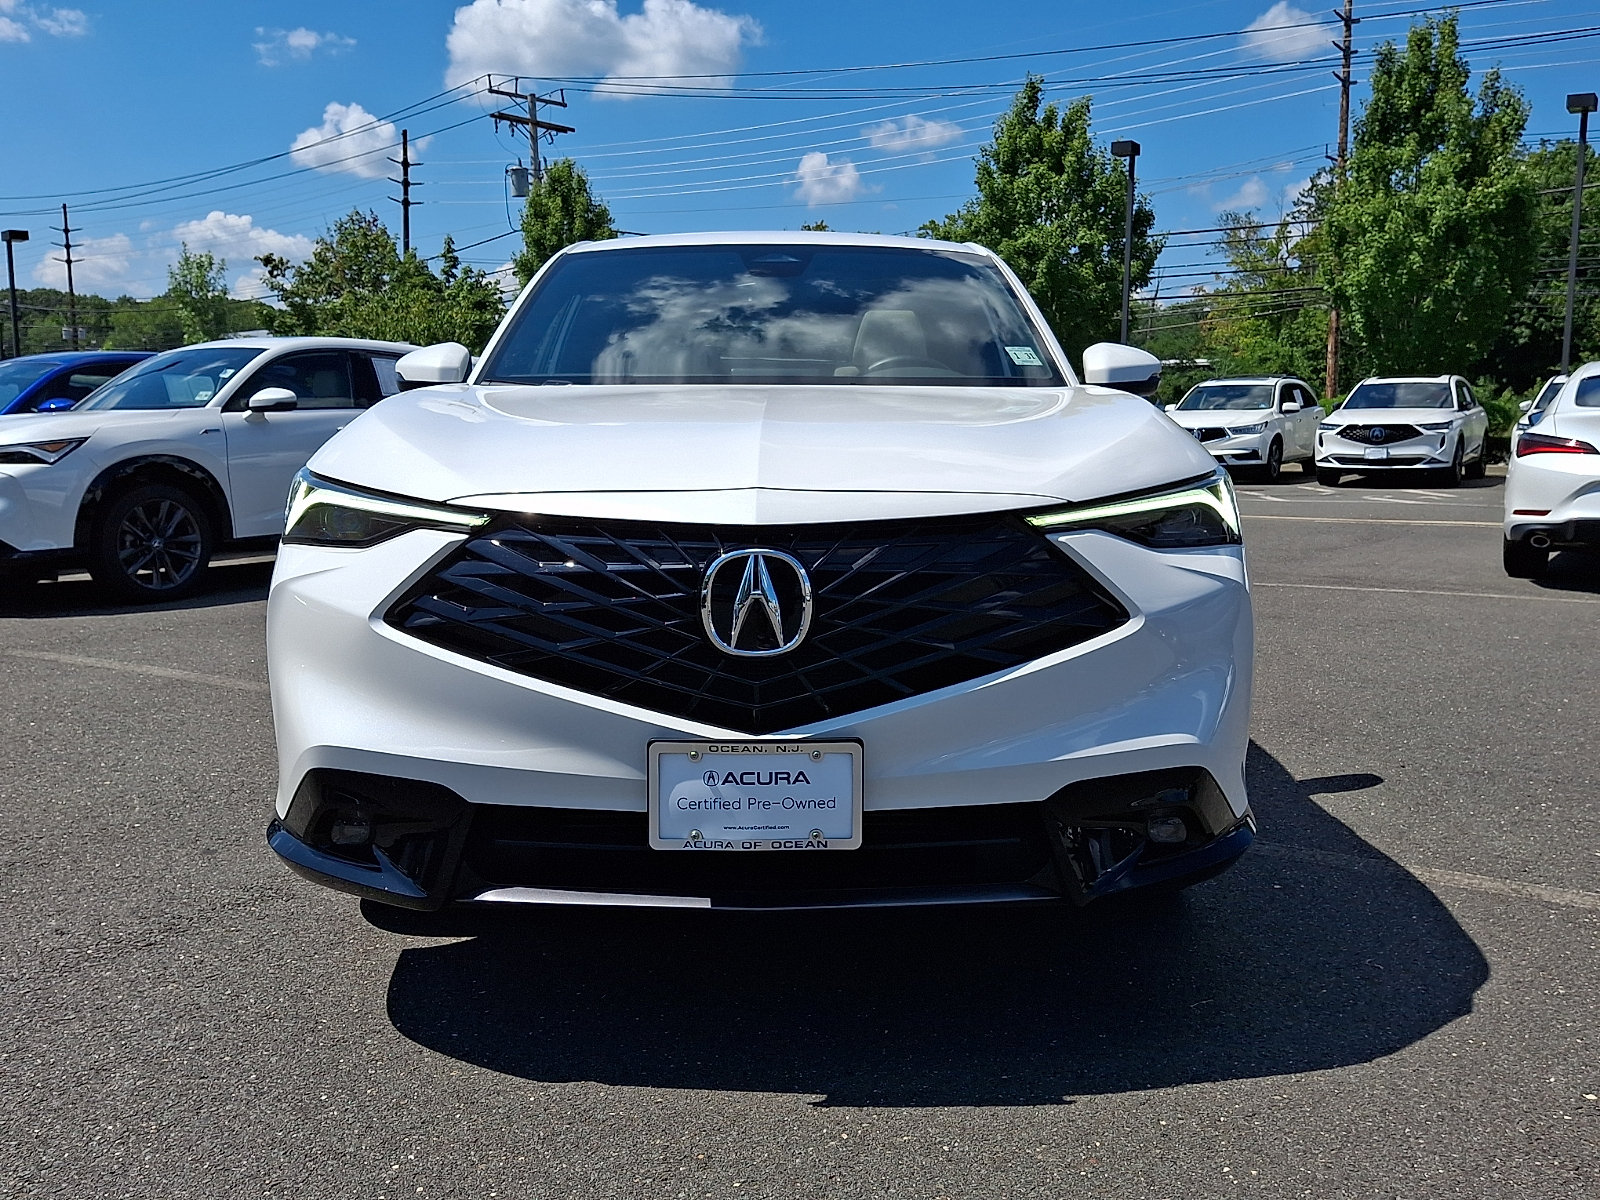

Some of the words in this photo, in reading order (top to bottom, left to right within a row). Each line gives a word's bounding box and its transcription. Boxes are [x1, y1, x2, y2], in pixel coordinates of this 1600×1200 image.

[775, 745, 804, 753] N.J.
[721, 771, 811, 786] ACURA
[676, 797, 741, 810] Certified
[747, 797, 837, 810] Pre-Owned
[682, 841, 734, 849] ACURA
[741, 841, 763, 850] OF
[770, 840, 829, 849] OCEAN
